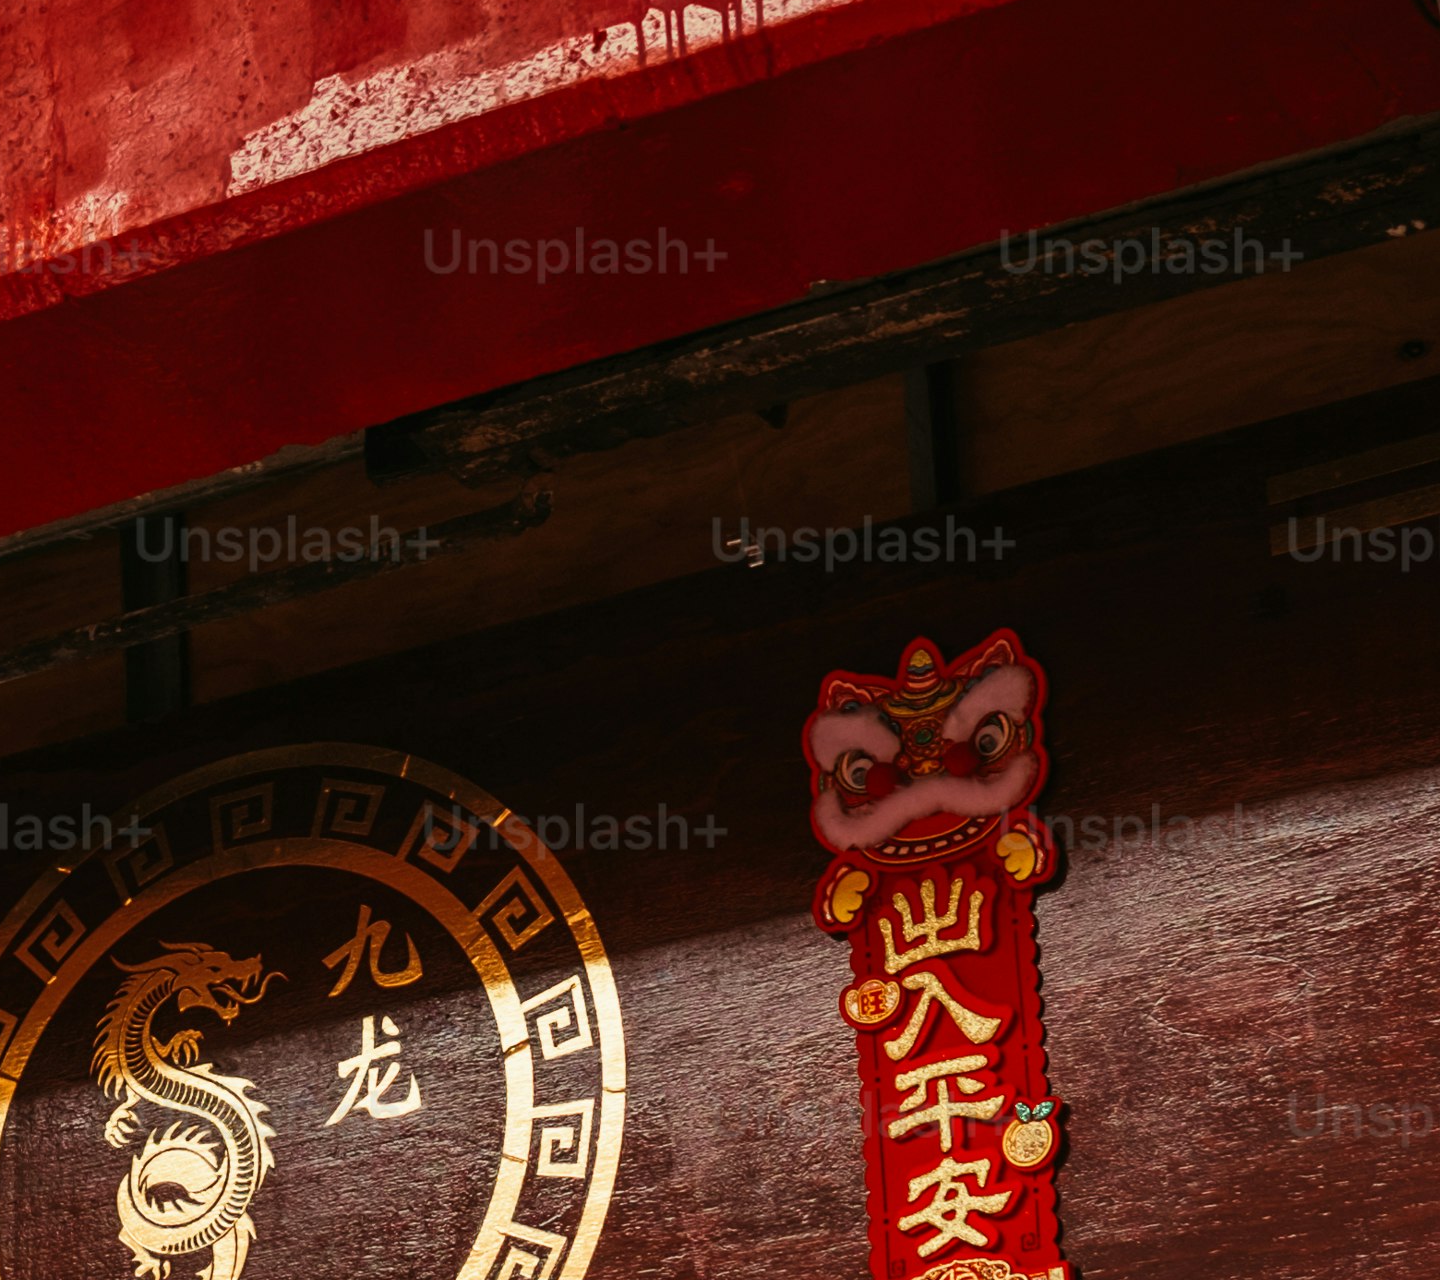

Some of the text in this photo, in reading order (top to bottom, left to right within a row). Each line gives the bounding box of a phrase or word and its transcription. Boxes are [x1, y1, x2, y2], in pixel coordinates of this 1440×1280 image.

[323, 903, 422, 1127] 九龙
[877, 877, 1013, 1258] 出入平安
